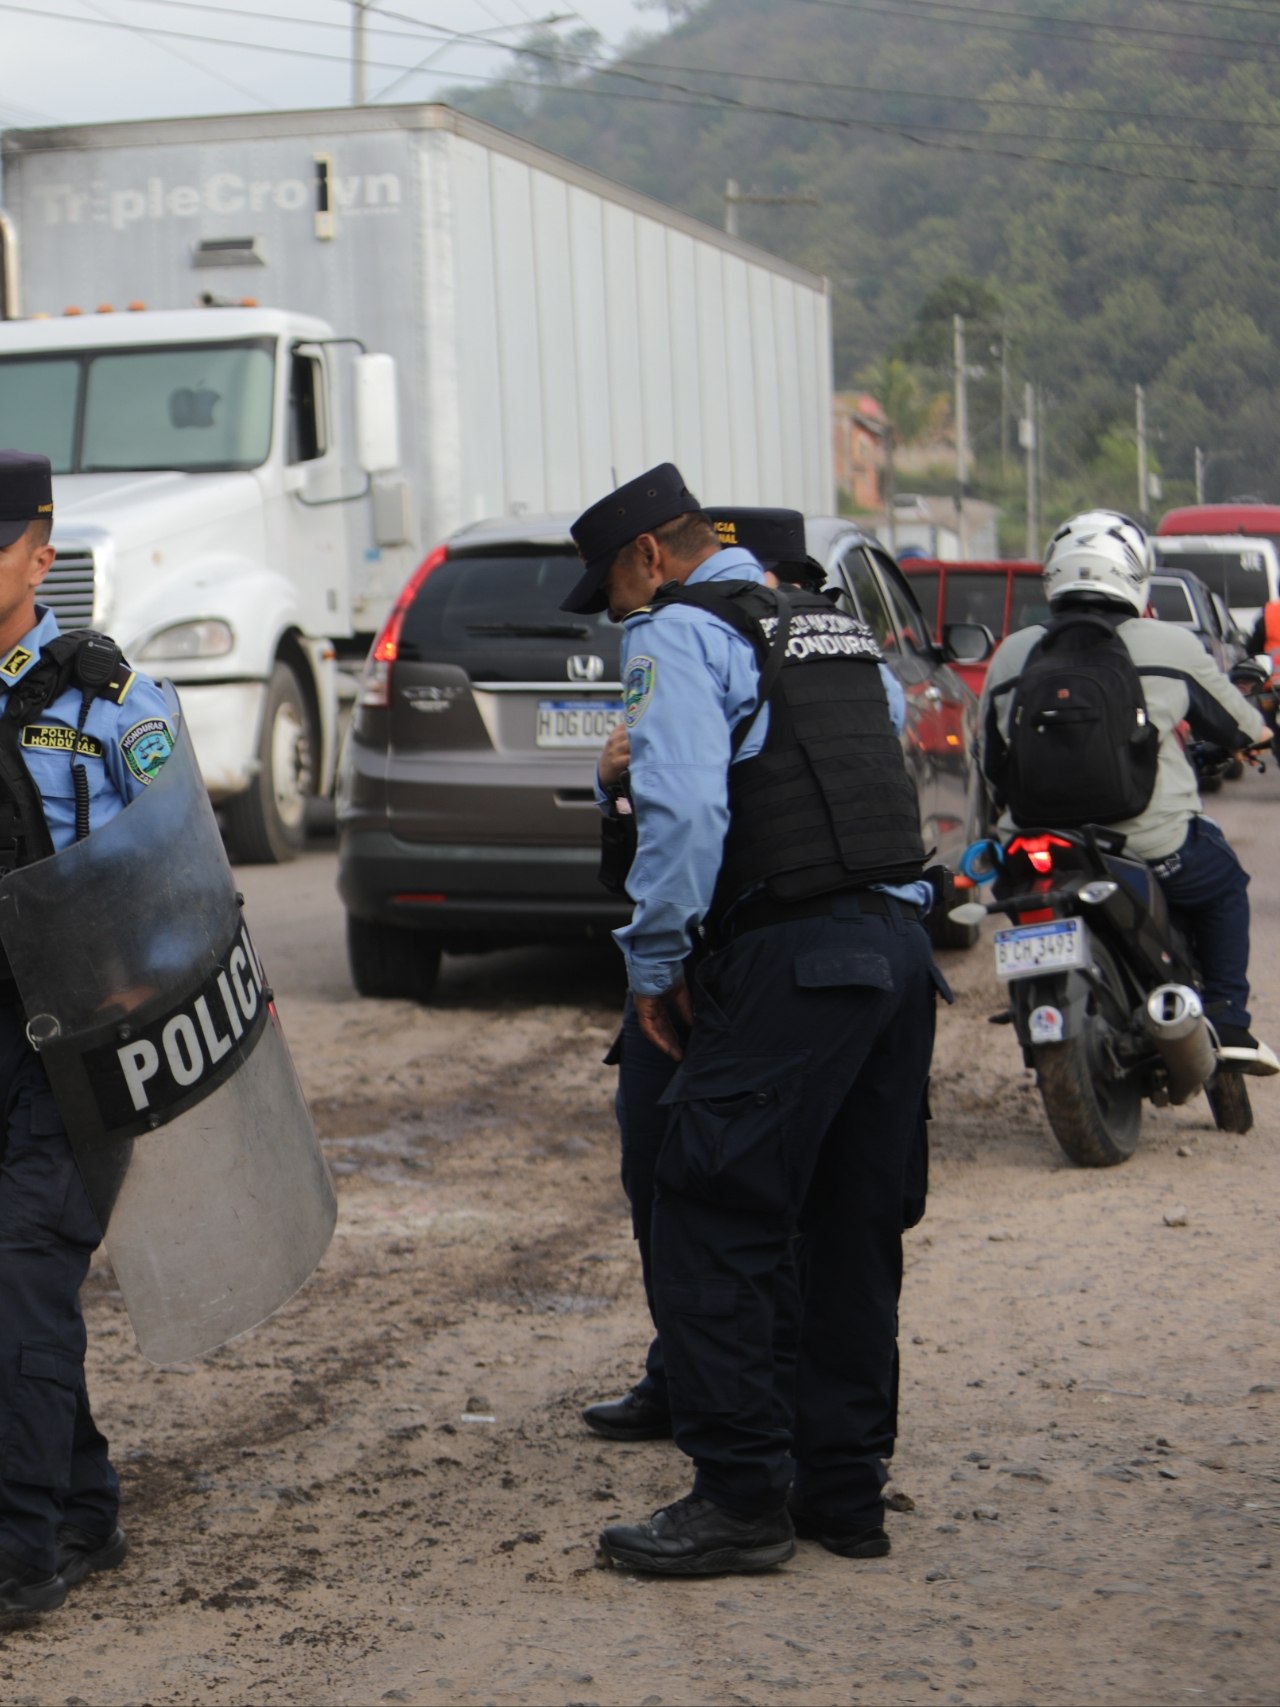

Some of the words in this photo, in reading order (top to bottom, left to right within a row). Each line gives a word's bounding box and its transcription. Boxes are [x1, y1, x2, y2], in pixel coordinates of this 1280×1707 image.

[784, 634, 883, 658] ONDURAS
[40, 729, 89, 742] POLICA
[123, 722, 164, 748] HONDURAS
[117, 926, 264, 1111] POLICI
